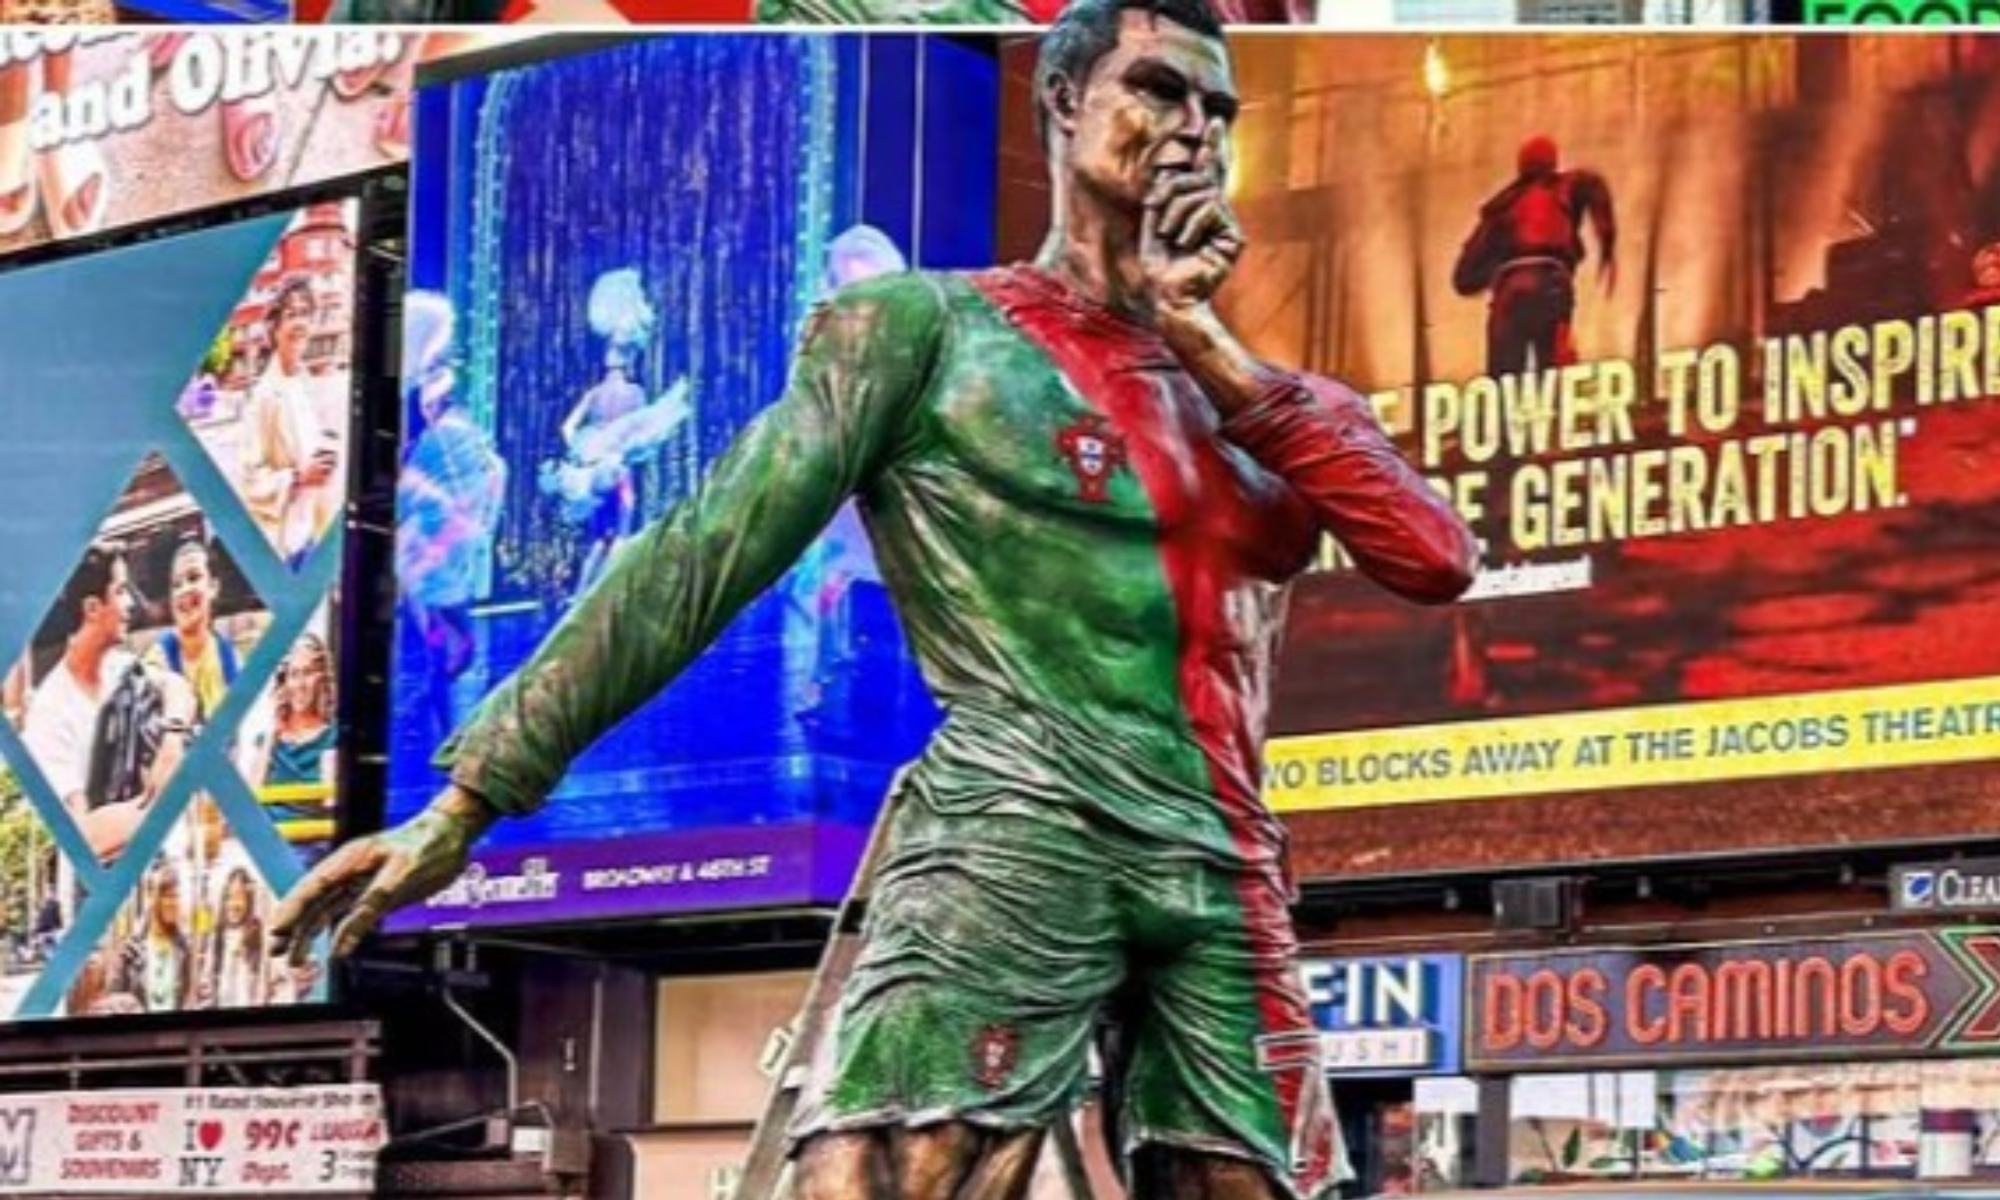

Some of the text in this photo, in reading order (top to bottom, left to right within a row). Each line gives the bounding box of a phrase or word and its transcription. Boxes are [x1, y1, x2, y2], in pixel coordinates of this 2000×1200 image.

[29, 53, 152, 151] and
[1423, 358, 1636, 468] POWER
[1659, 343, 1739, 436] TO
[1316, 748, 1452, 786] BLOCKS
[1461, 739, 1563, 776] AWAY
[1573, 734, 1617, 768] AT
[1625, 727, 1694, 763] THE
[1704, 714, 1850, 758] JACOBS
[1484, 949, 1928, 1051] DOS CAMINOS
[1328, 1035, 1419, 1063] USHI
[68, 1102, 160, 1124] DISCOUNT
[178, 1157, 225, 1188] NY
